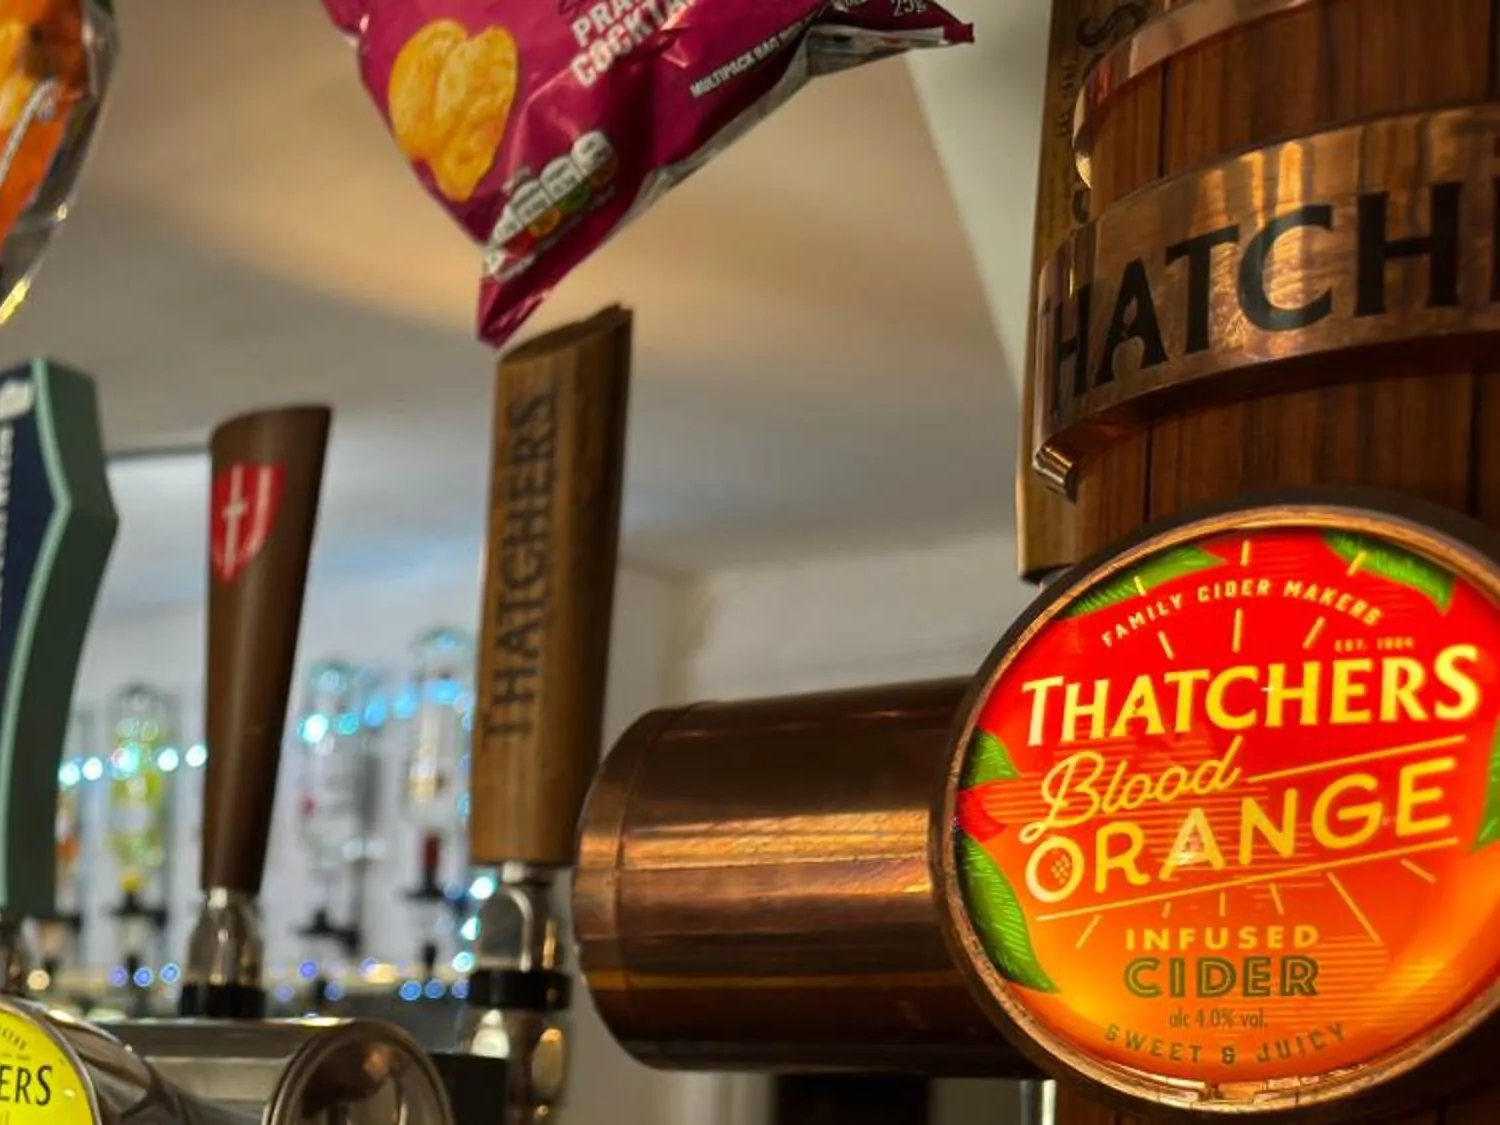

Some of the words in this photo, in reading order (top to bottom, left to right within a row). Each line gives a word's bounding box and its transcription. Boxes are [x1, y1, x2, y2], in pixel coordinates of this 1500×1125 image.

[690, 52, 755, 98] MULTIPACK
[1050, 182, 1500, 416] HATCH
[485, 386, 559, 748] THATCHERS
[1102, 593, 1183, 647] FAMILY
[1197, 579, 1271, 602] CIDER
[1283, 579, 1385, 627] MAKERS
[1021, 643, 1481, 747] THATCHERS
[1018, 735, 1243, 845] Blood
[1024, 757, 1458, 904] ORANGE
[1125, 925, 1320, 952] INFUSED
[1122, 955, 1320, 998] CIDER
[1104, 1025, 1204, 1065] SWEET
[1220, 1047, 1238, 1066] &
[1255, 1022, 1350, 1063] JUICY
[1168, 1008, 1190, 1030] alc
[1194, 1008, 1235, 1029] 4.0%
[1240, 1007, 1269, 1030] vol.
